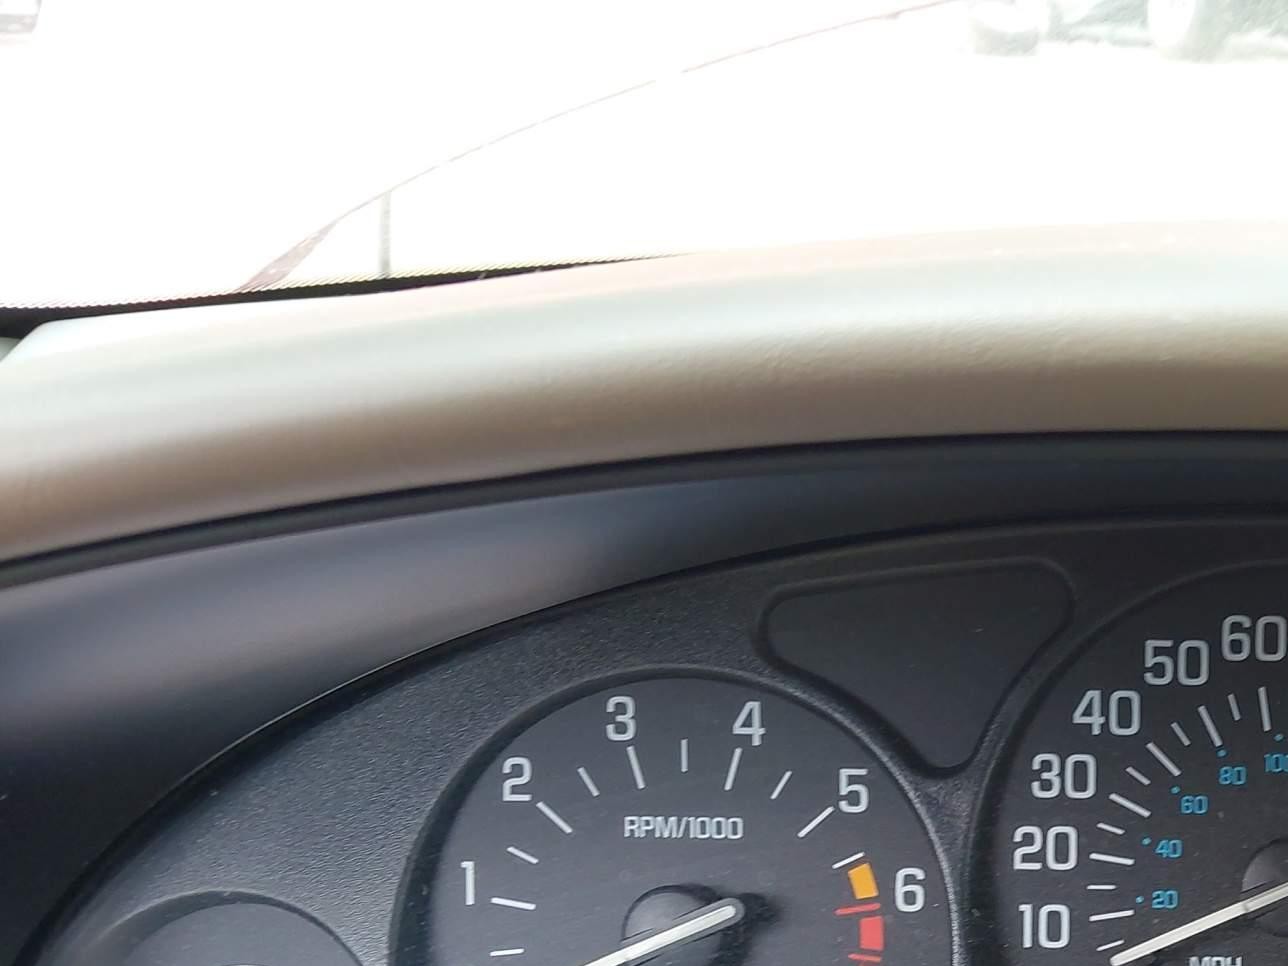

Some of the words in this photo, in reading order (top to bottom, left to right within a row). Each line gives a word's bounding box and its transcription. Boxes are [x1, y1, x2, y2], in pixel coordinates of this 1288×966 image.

[1221, 615, 1286, 662] 60
[1144, 640, 1210, 686] 50
[606, 696, 636, 741] 3
[732, 701, 765, 745] 4
[1072, 690, 1141, 736] 40
[502, 758, 533, 802] 2
[838, 768, 869, 813] 5
[1031, 753, 1096, 799] 30
[1219, 766, 1246, 786] 80
[1180, 796, 1208, 814] 60
[624, 816, 744, 839] RPM/1000
[1012, 826, 1078, 870] 20
[1155, 840, 1182, 858] 40
[461, 861, 476, 905] 1
[894, 868, 925, 911] 6
[1152, 890, 1178, 908] 20
[1018, 904, 1070, 949] 10
